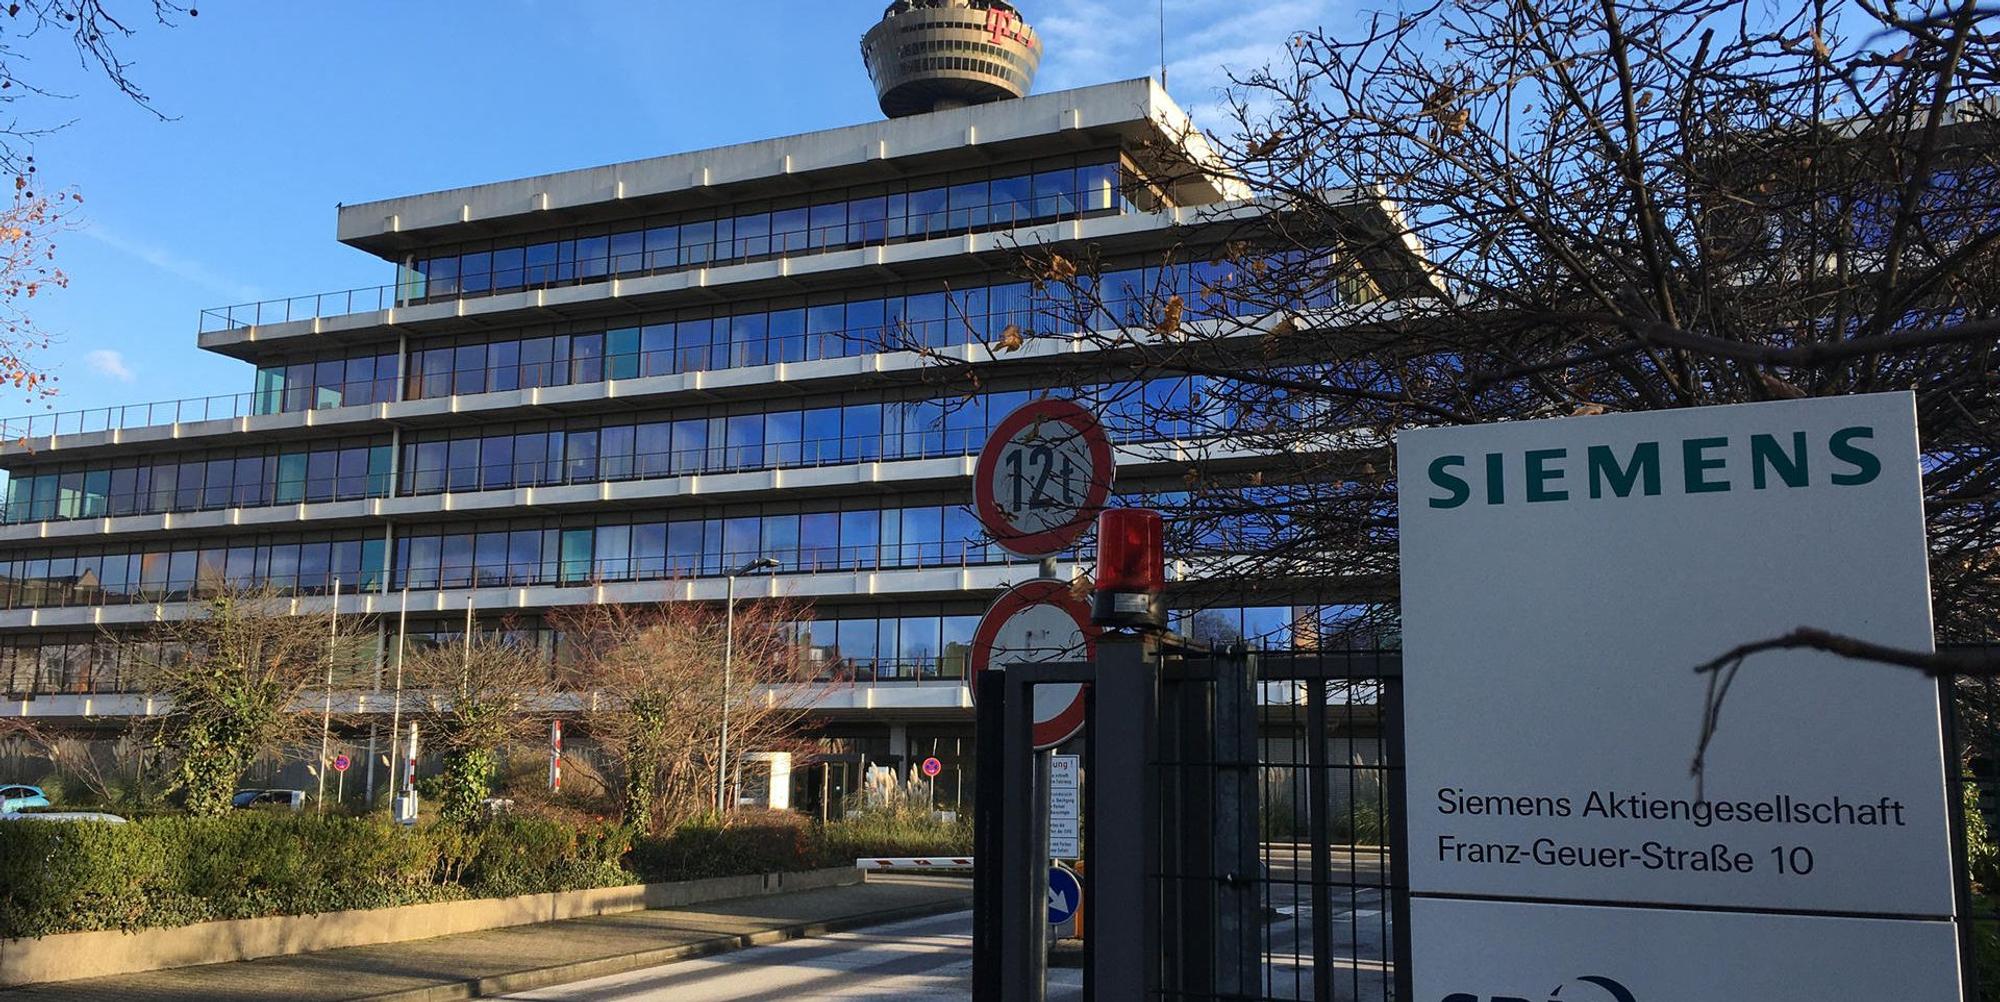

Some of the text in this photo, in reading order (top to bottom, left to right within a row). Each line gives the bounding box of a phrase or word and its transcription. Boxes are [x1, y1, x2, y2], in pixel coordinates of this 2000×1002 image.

[1427, 426, 1882, 510] SIEMENS
[1437, 787, 1907, 828] Siemens Aktiengesellschaft
[1438, 835, 1814, 876] Franz-Geuer-Straße 10
